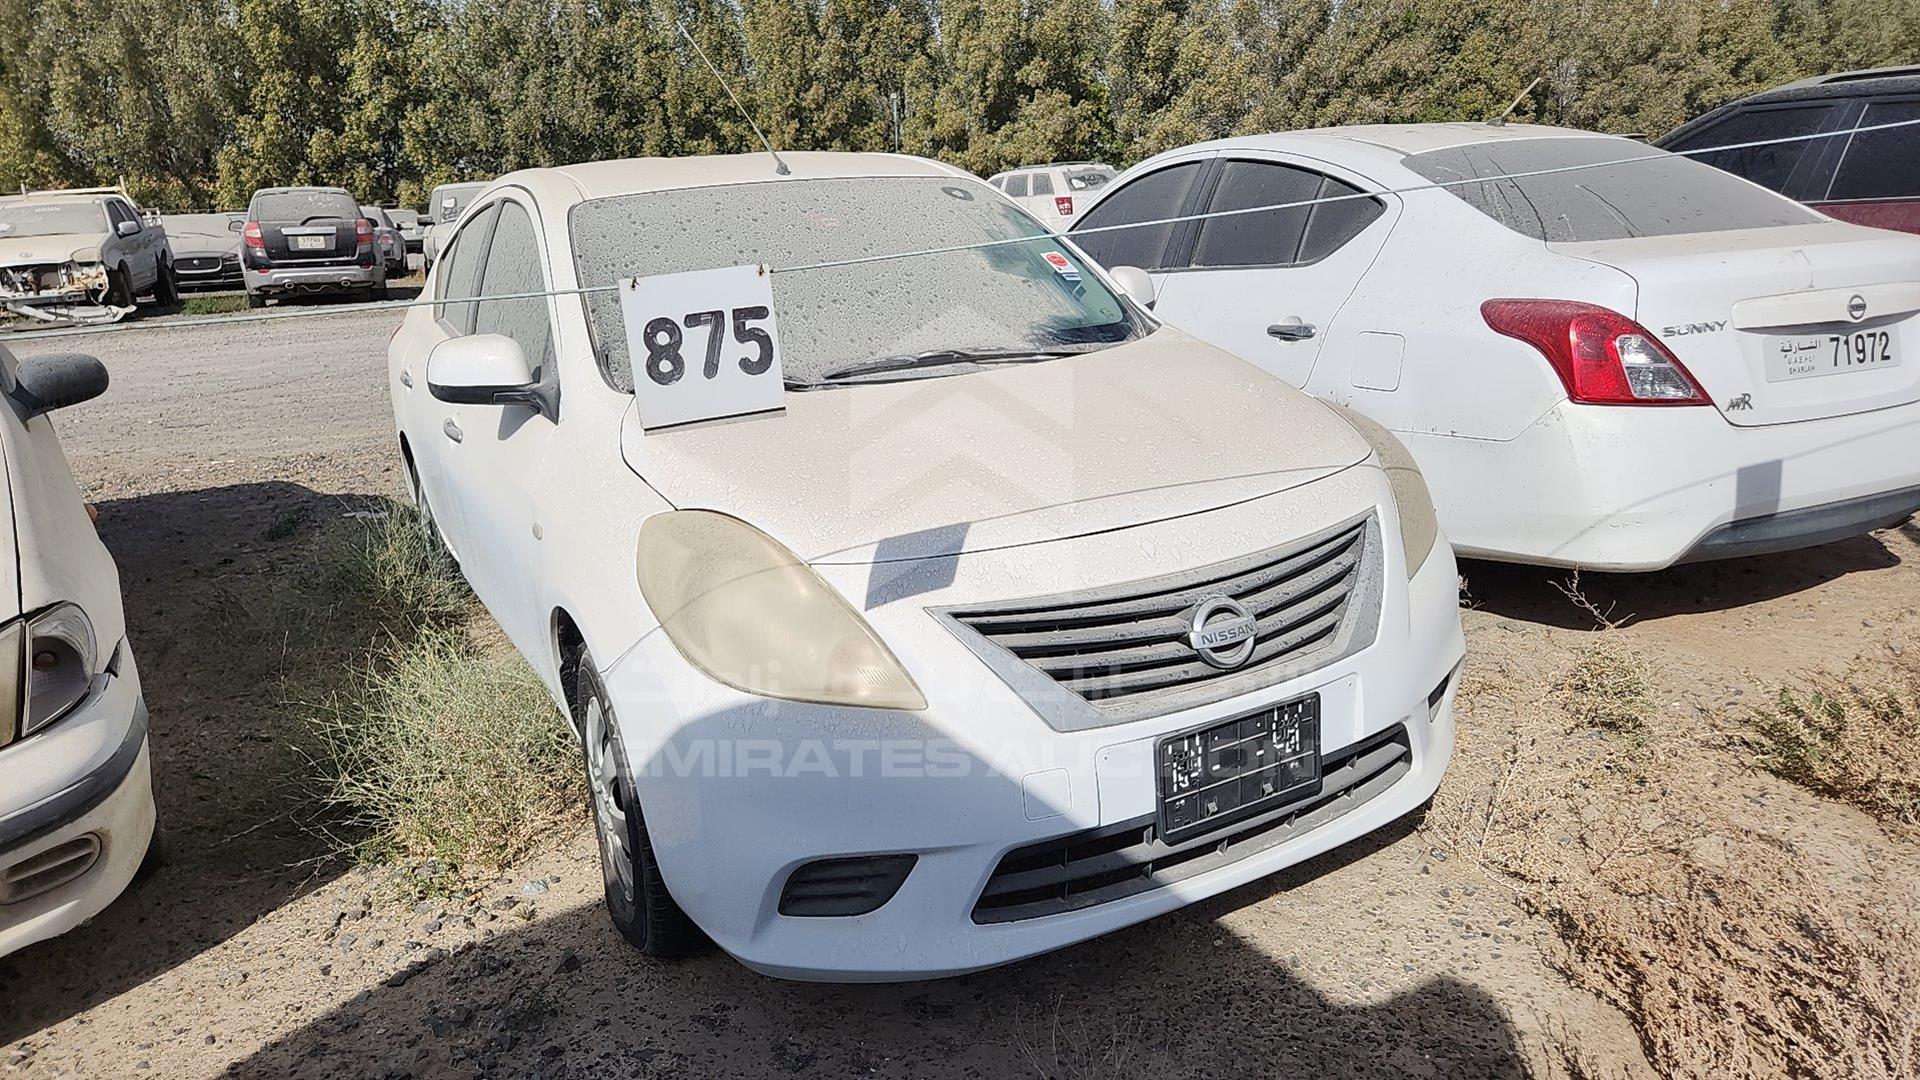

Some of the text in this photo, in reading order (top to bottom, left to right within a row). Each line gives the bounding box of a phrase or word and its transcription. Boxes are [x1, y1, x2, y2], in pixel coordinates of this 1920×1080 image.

[1662, 320, 1728, 338] SUNNY
[643, 305, 774, 386] 875
[1829, 331, 1891, 367] 71972
[1201, 622, 1254, 645] NISSAN
